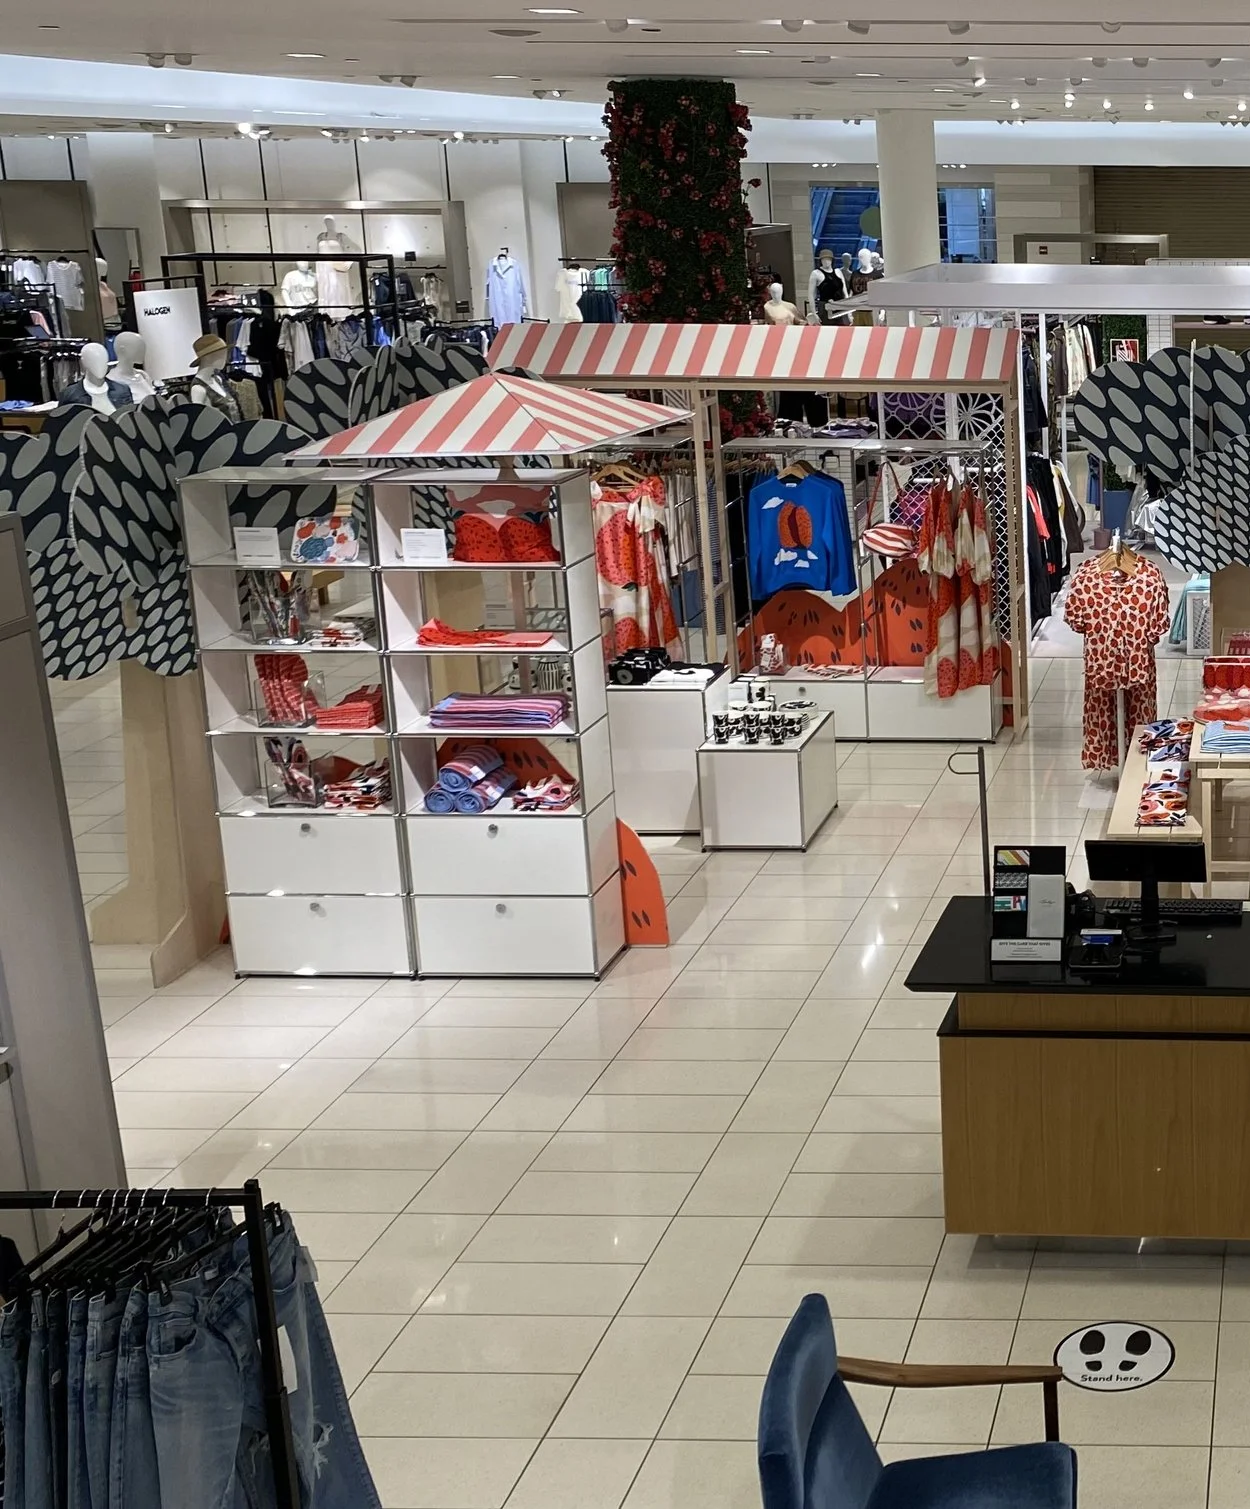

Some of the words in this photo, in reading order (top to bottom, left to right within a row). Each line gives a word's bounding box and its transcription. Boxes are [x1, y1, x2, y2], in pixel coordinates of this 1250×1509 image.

[143, 306, 171, 316] HALOGEN
[1080, 1374, 1113, 1382] Stand
[1115, 1374, 1143, 1382] here.
